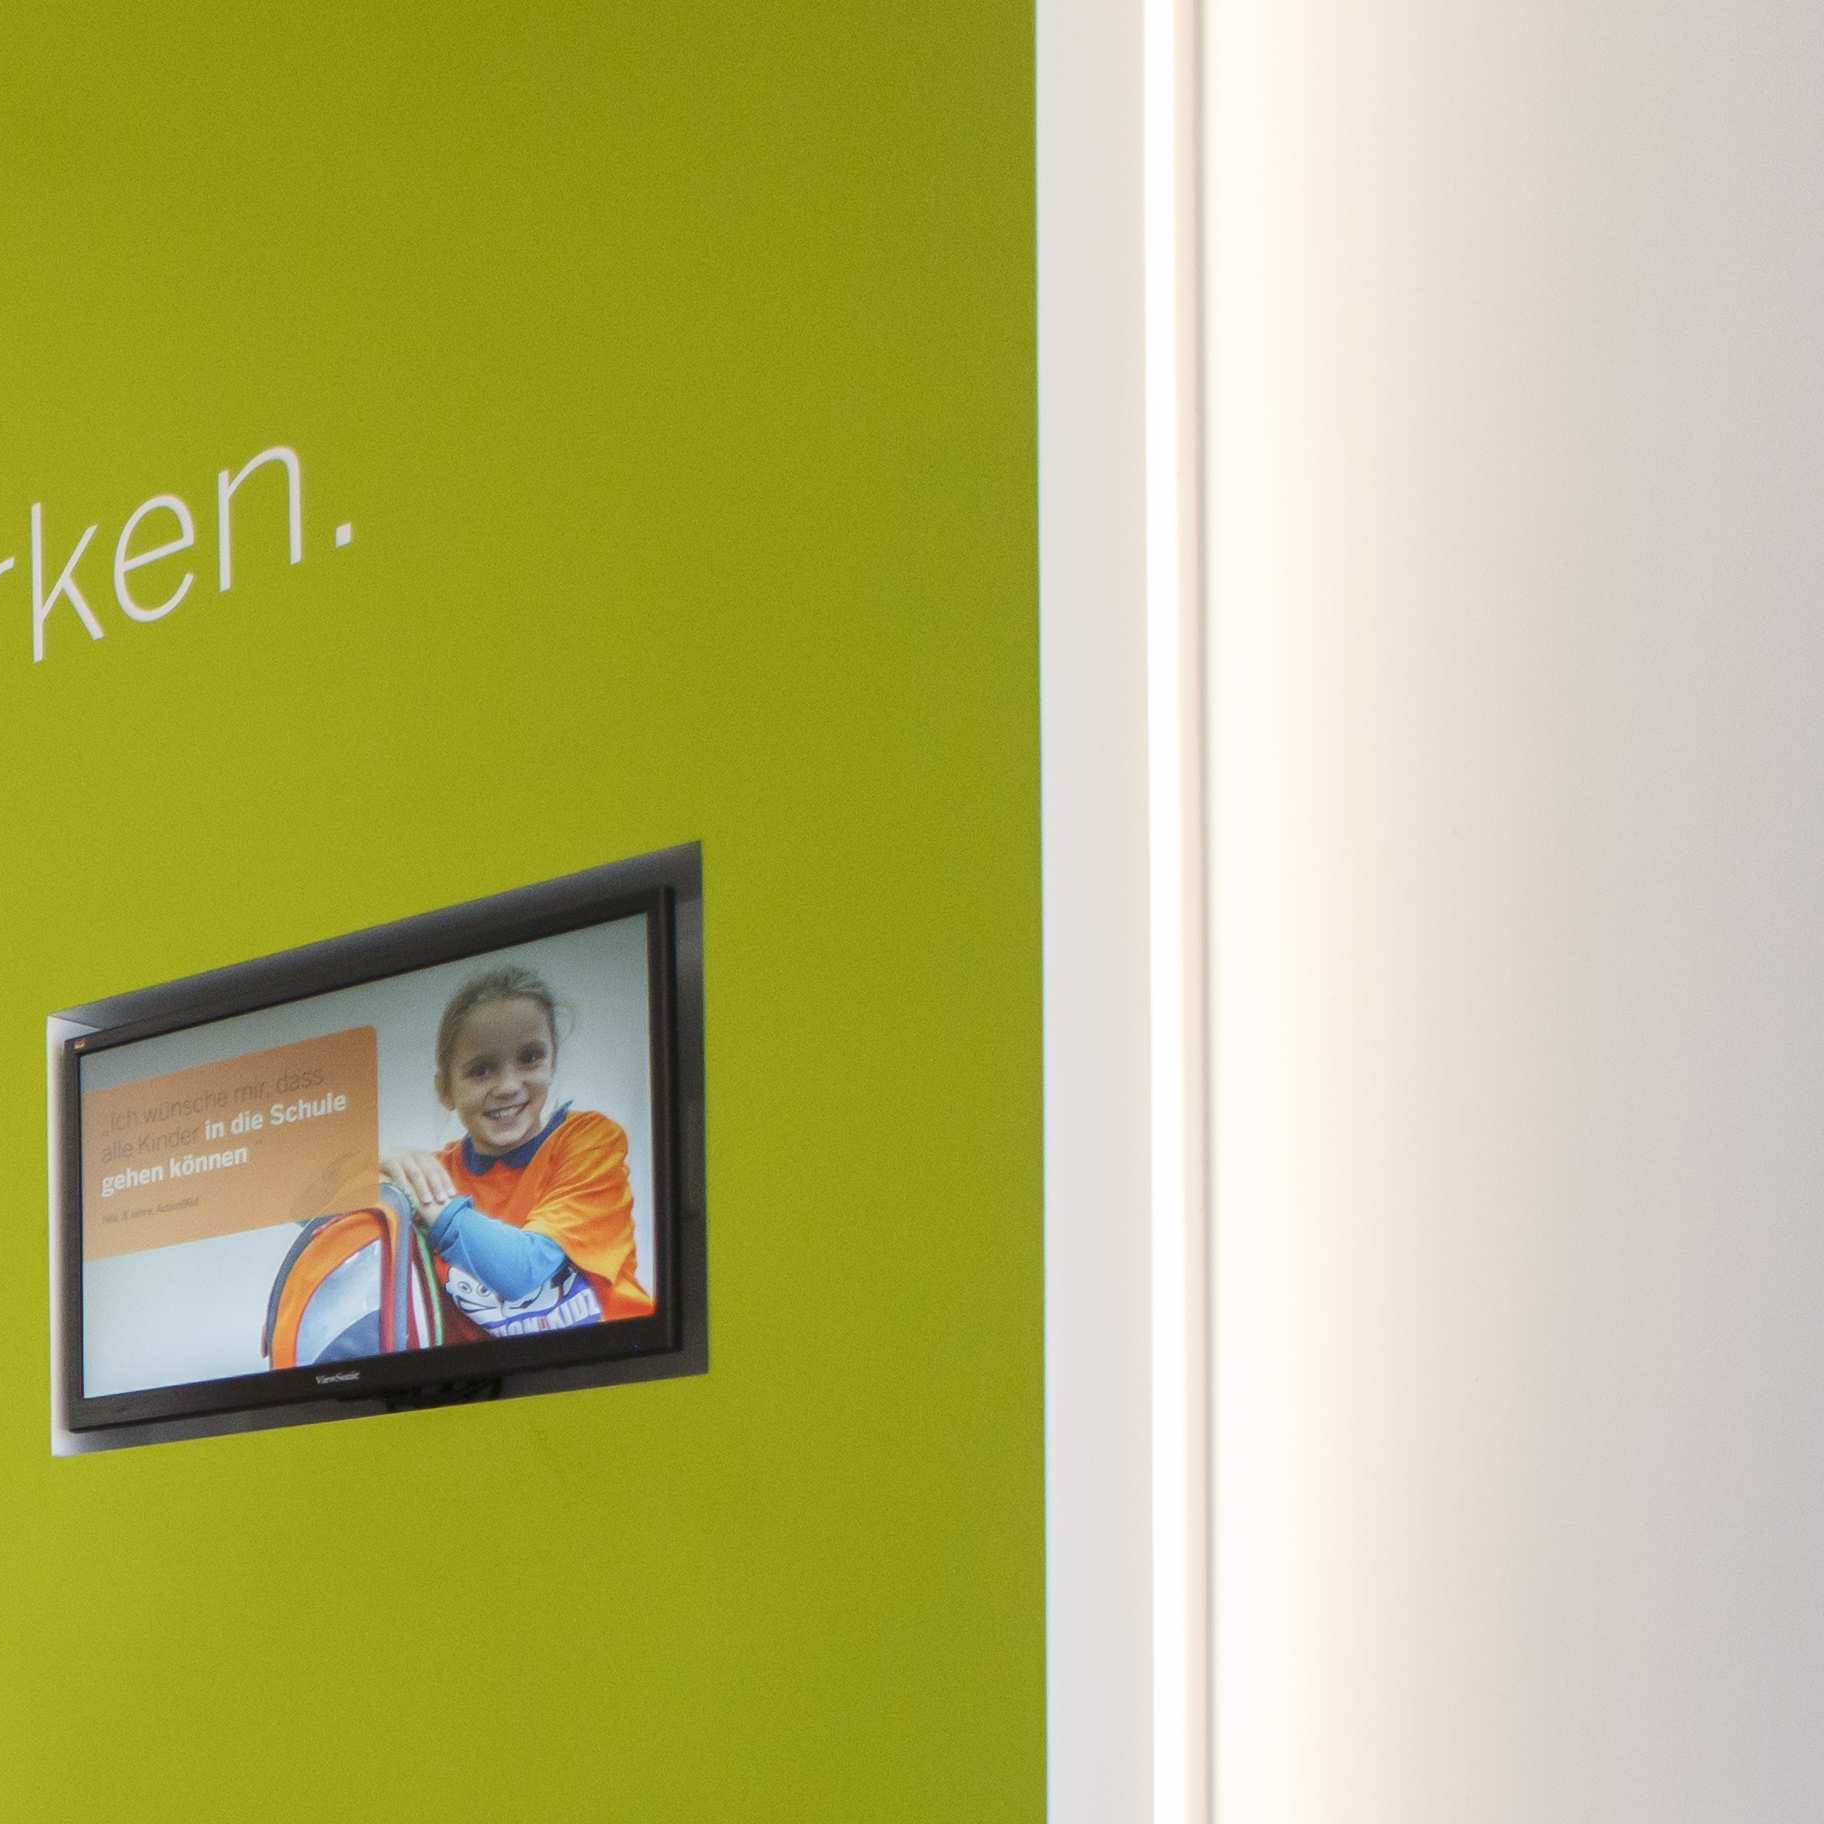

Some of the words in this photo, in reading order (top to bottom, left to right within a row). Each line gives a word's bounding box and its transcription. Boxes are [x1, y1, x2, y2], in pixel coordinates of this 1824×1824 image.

[101, 1140, 134, 1164] alle
[138, 1120, 201, 1153] Kinder
[204, 1118, 225, 1141] in
[230, 1110, 264, 1136] die
[269, 1091, 348, 1128] Schule
[101, 1165, 164, 1198] gehen
